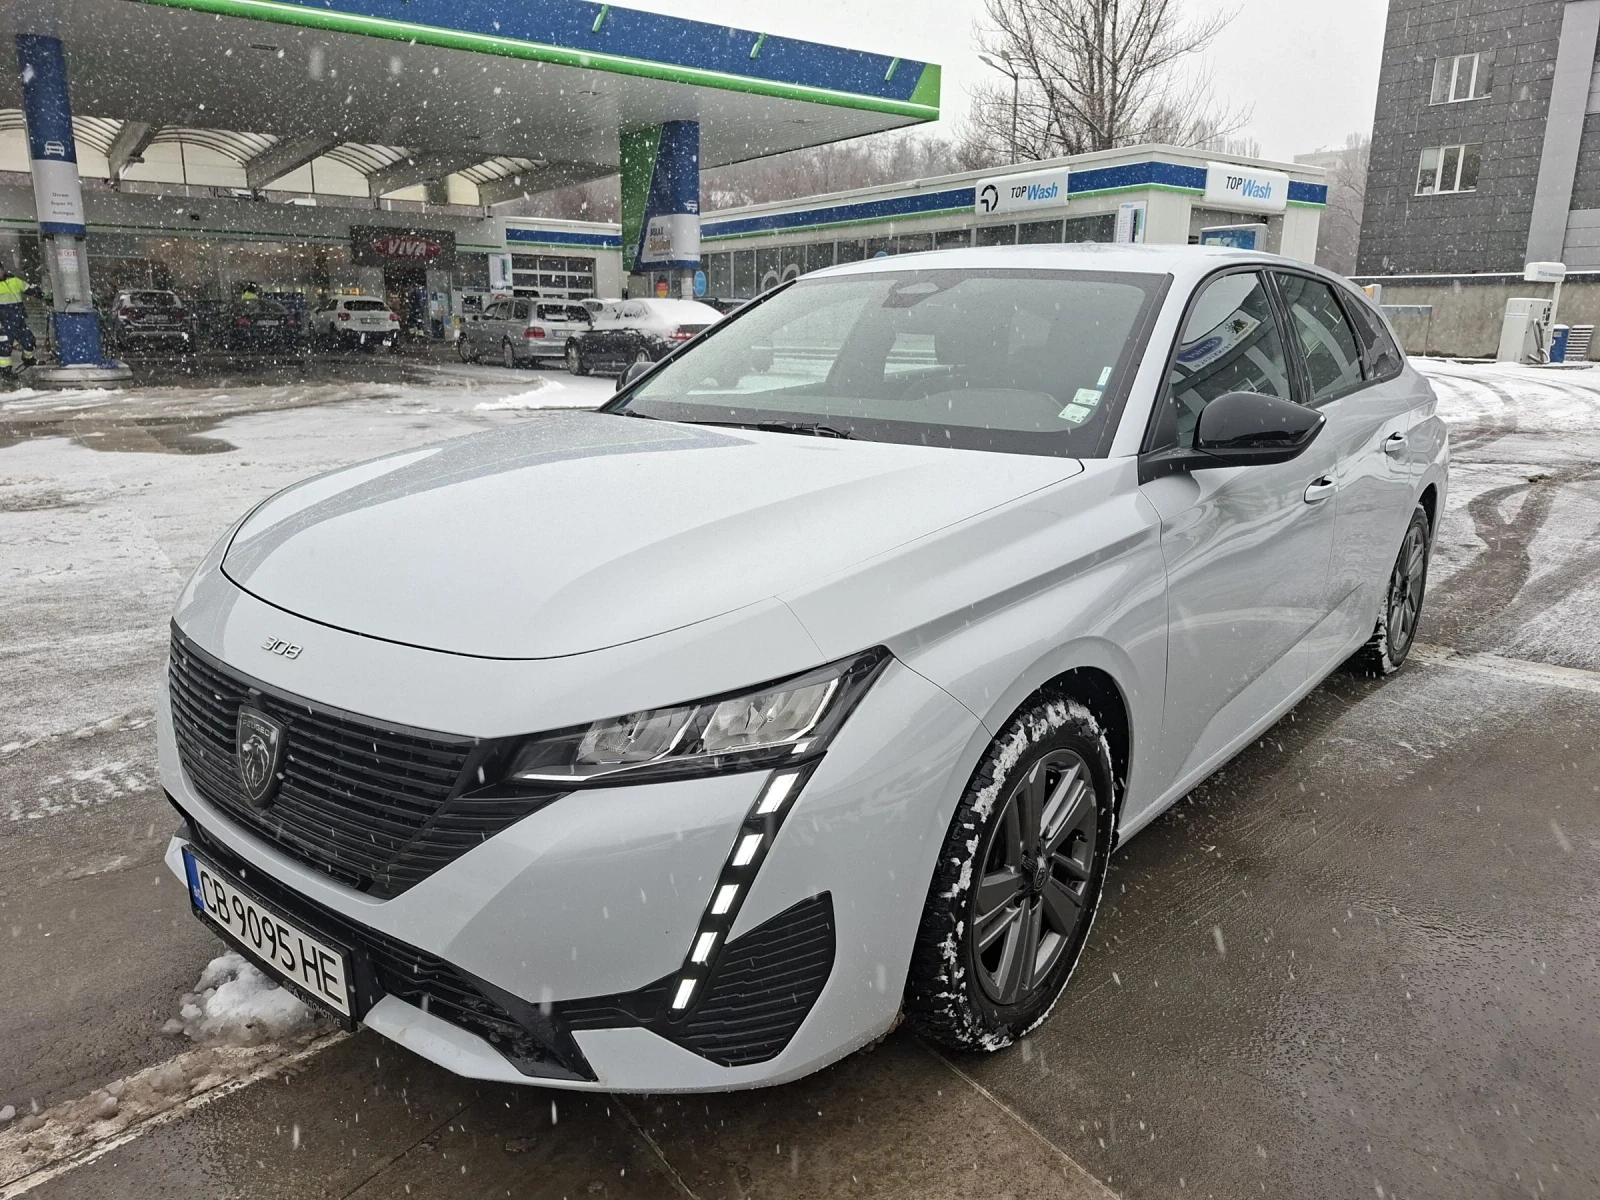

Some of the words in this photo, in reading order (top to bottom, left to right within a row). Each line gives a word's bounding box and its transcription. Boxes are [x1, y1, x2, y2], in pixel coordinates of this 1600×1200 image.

[388, 239, 427, 257] VIVA
[260, 635, 304, 660] 308
[242, 719, 277, 740] PEUGEO
[200, 869, 231, 925] CB
[231, 894, 296, 973] 9095
[298, 937, 343, 1006] HE
